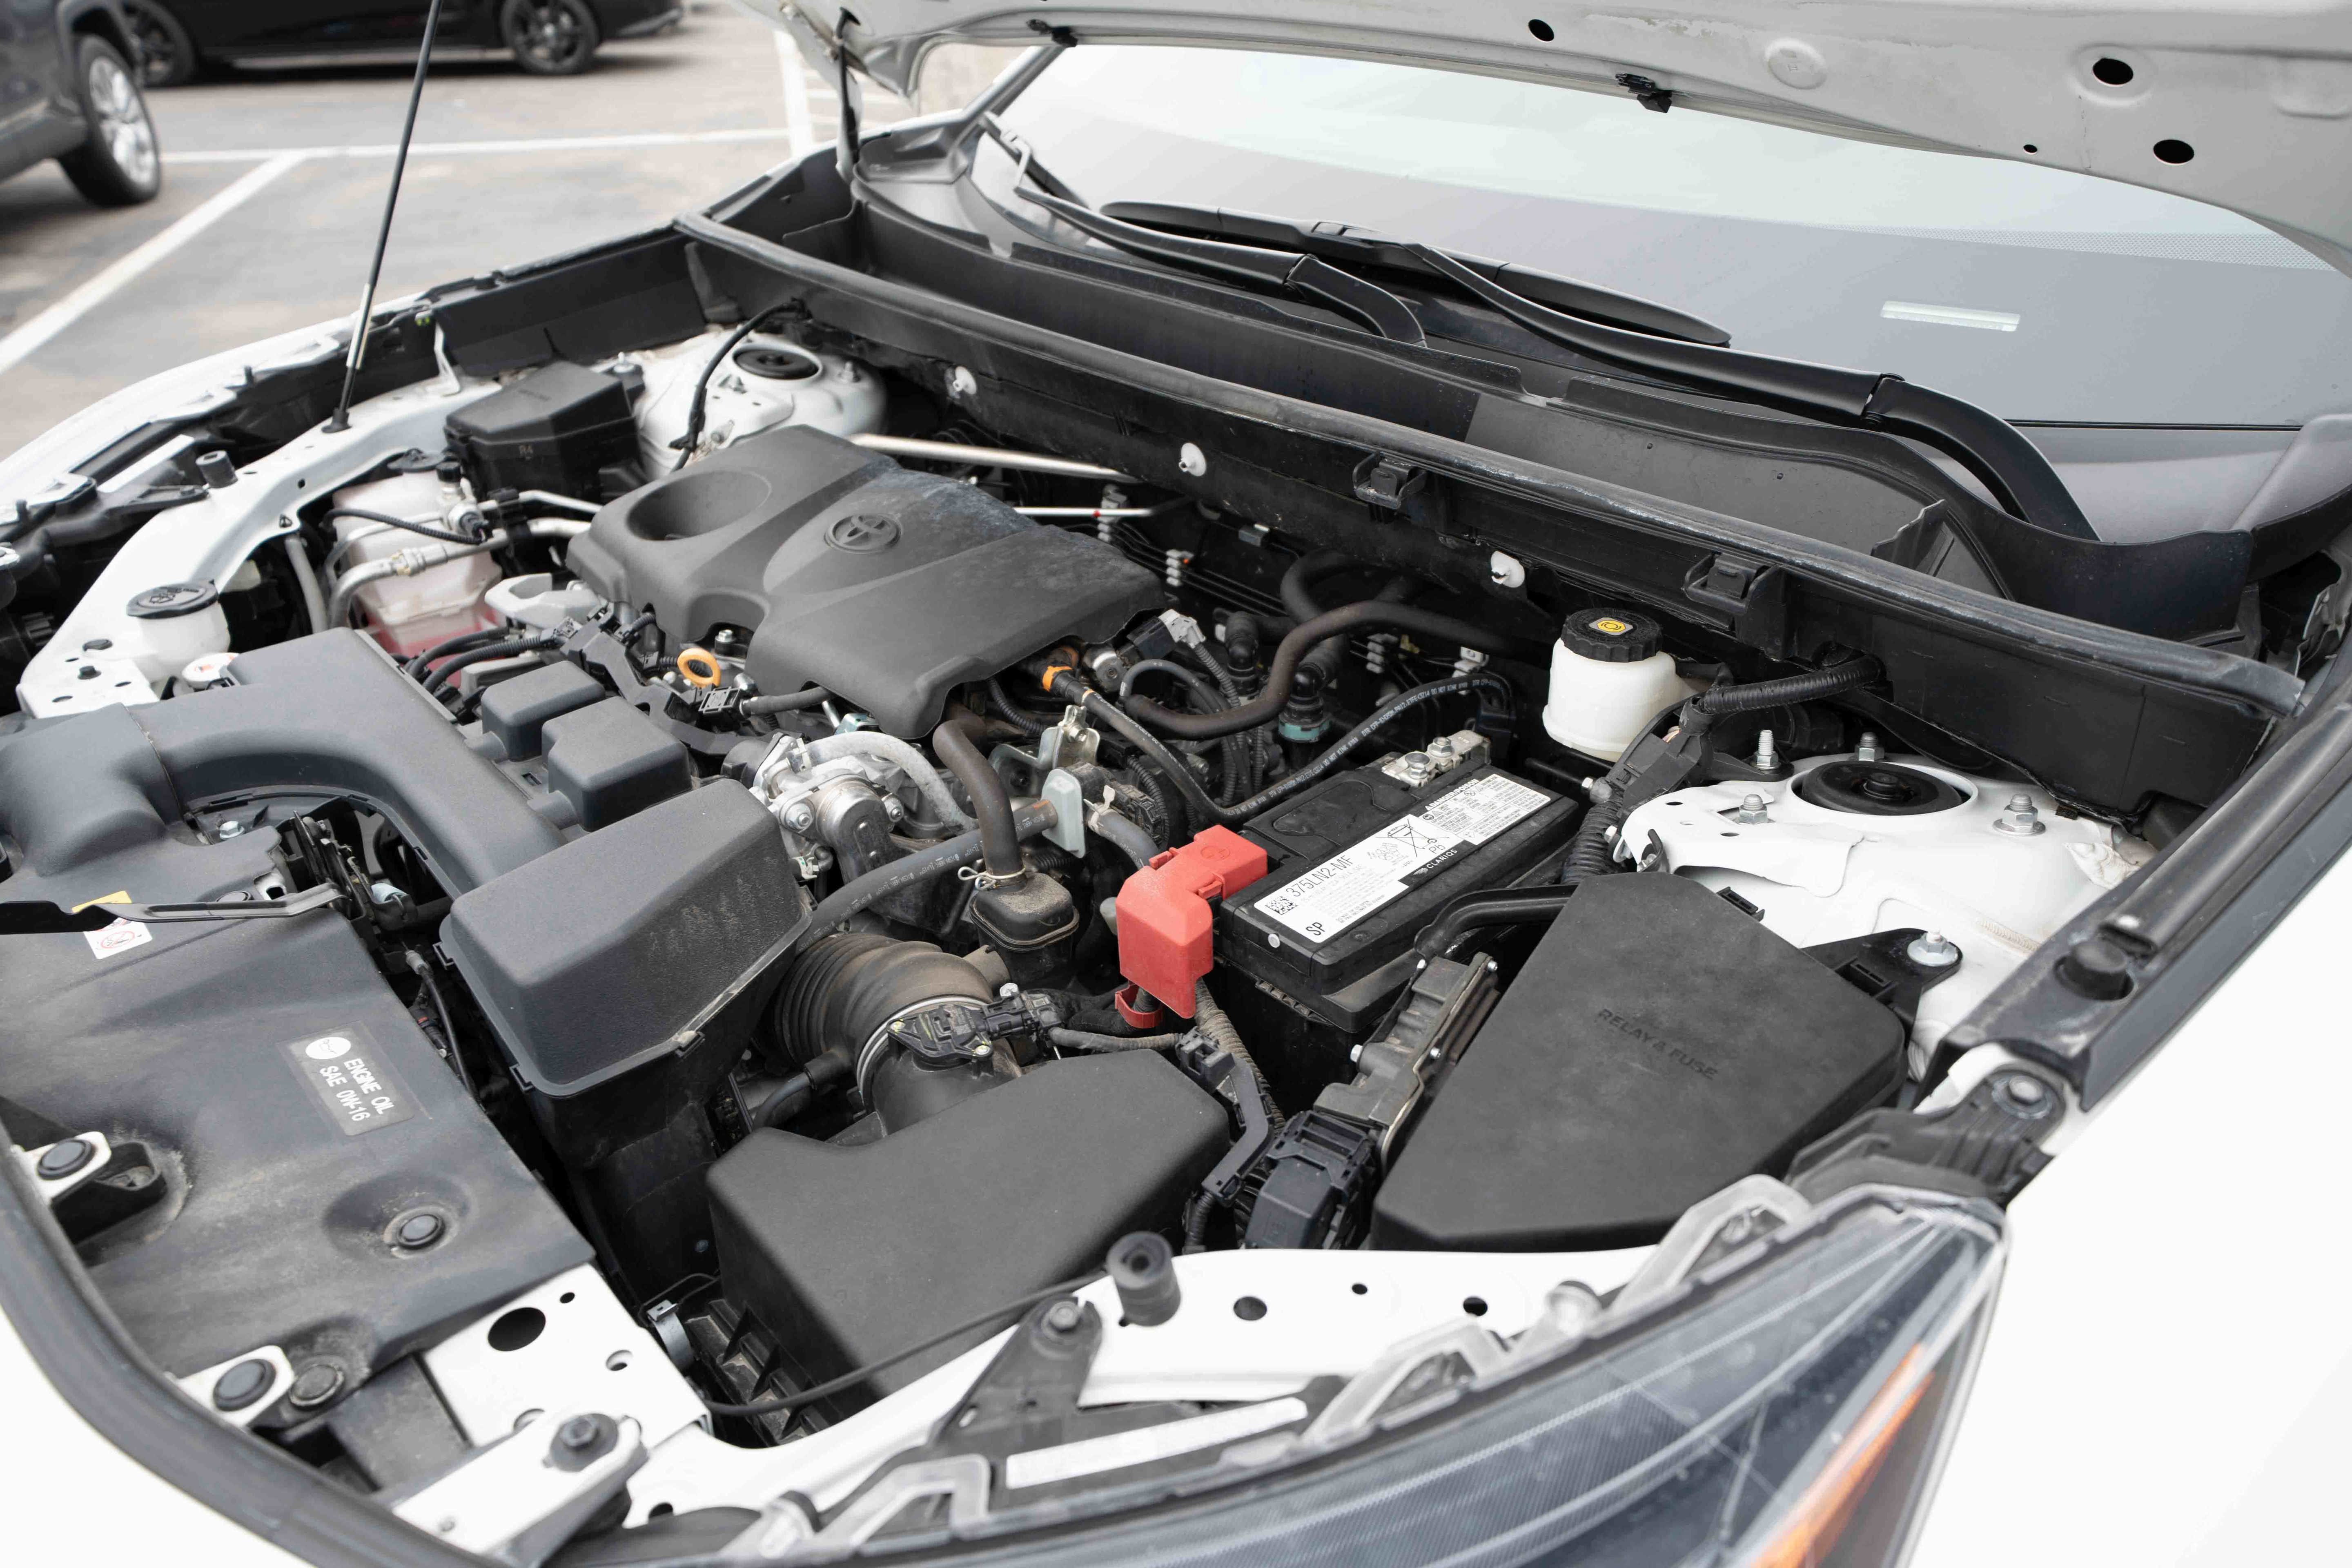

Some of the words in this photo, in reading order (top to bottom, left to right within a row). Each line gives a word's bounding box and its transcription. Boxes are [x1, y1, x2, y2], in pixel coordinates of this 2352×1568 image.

[1429, 844, 1446, 854] Pb
[1286, 855, 1353, 897] 375LN2-MF
[1306, 922, 1325, 936] SP
[1598, 1008, 1656, 1042] RELAY
[1669, 1048, 1718, 1080] FUSE
[320, 1065, 347, 1087] SAE
[336, 1089, 371, 1121] 0W-16
[343, 1058, 382, 1094] ENGINE
[371, 1096, 394, 1115] OIL
